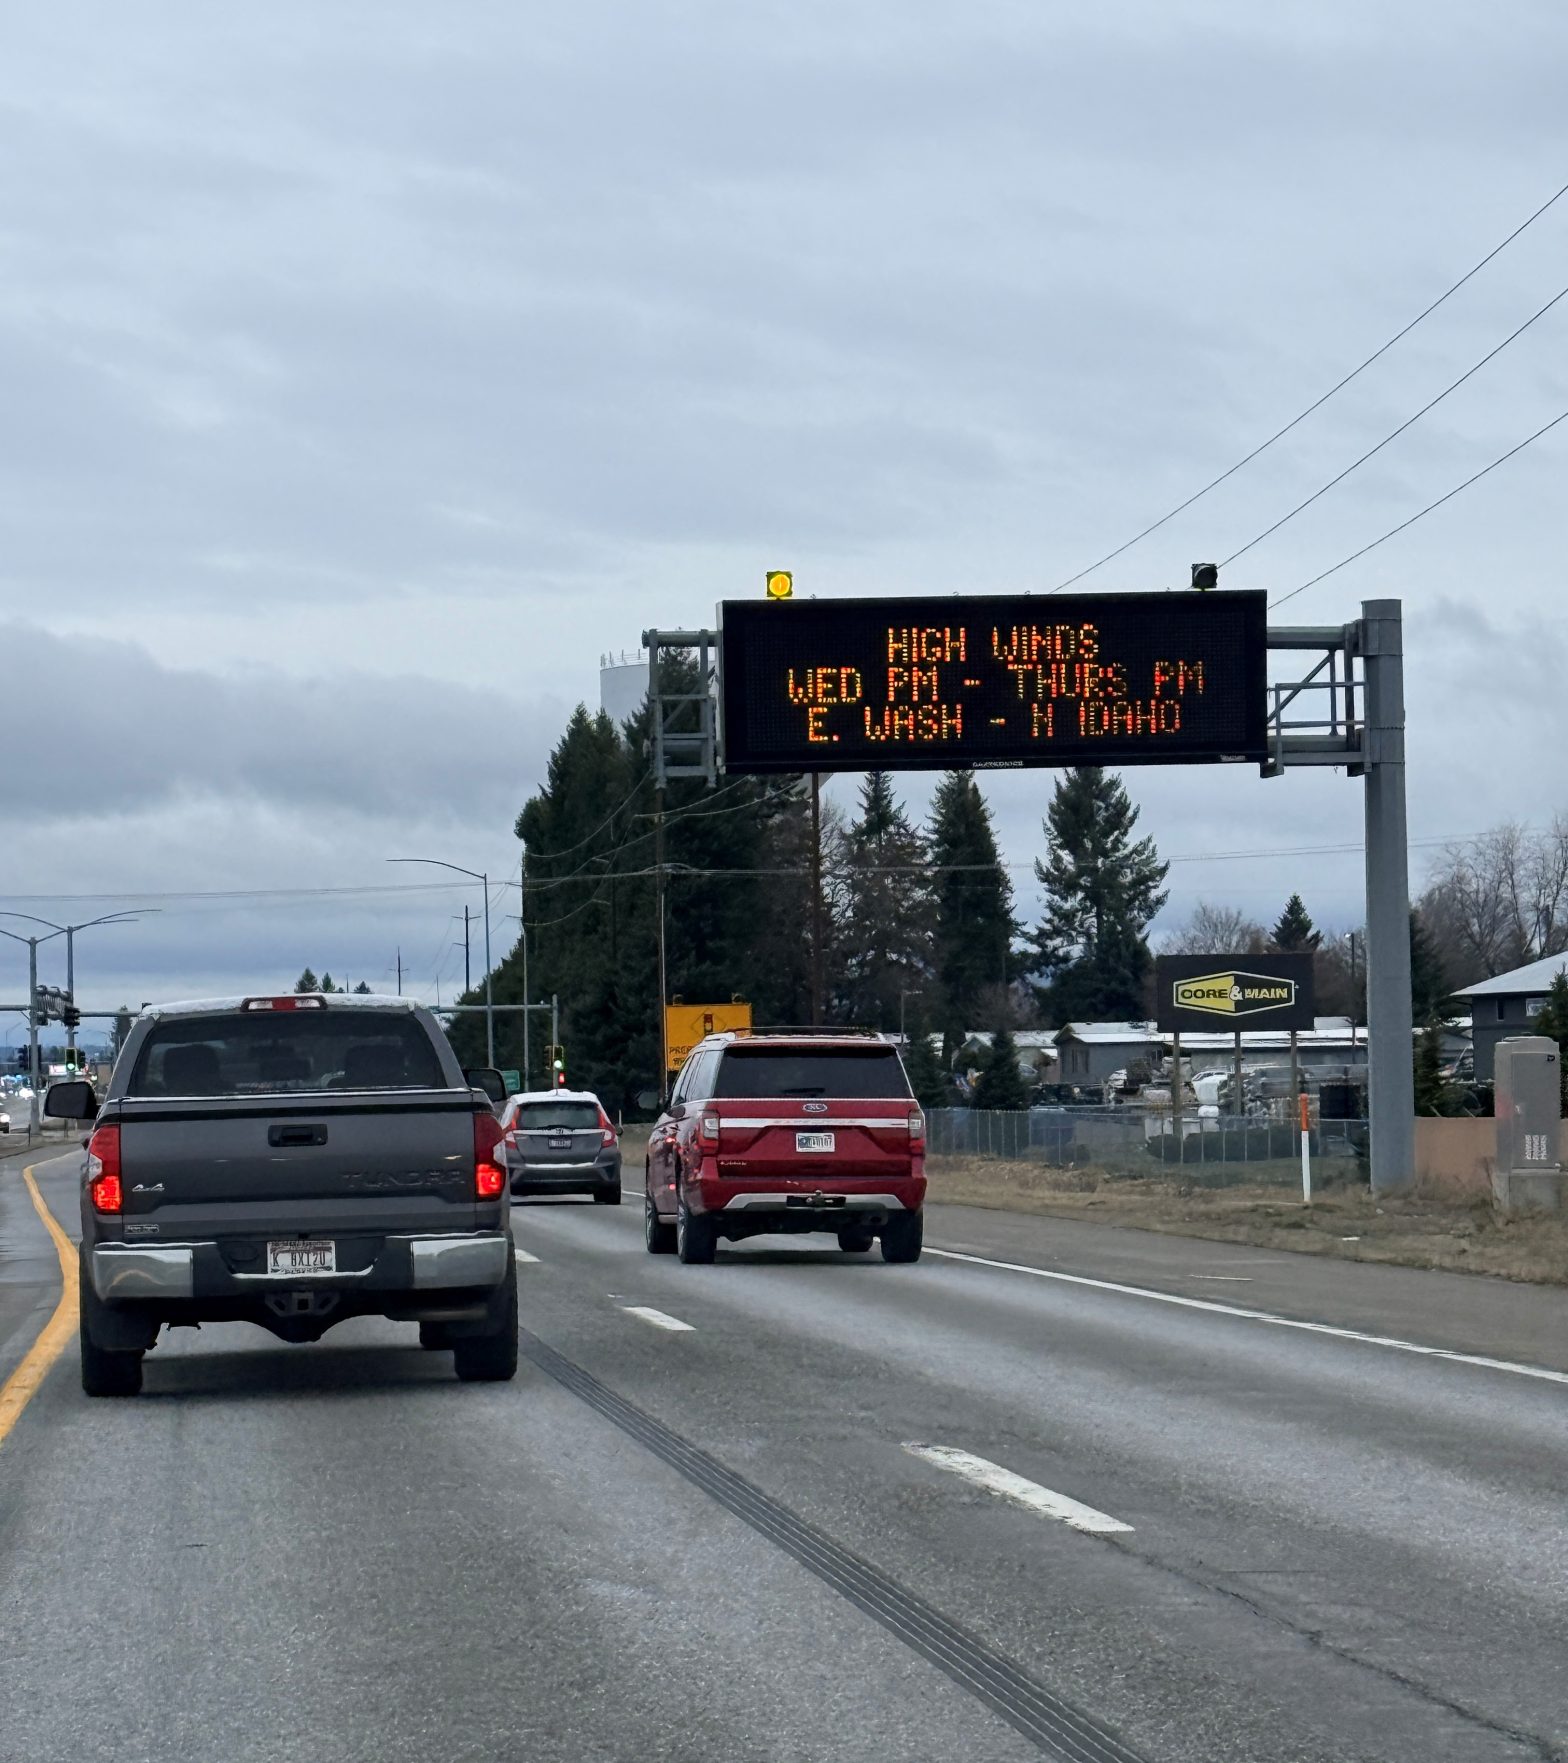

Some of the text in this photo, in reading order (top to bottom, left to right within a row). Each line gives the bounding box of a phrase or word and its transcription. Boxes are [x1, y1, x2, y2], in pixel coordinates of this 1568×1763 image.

[888, 623, 1099, 664] HIGH WINDS
[788, 667, 863, 704] WED
[888, 666, 939, 702] PM
[1007, 662, 1127, 699] THURS
[1154, 660, 1204, 696] PM
[808, 706, 839, 742] E.
[864, 704, 963, 740] WASH
[1031, 702, 1054, 737] N
[1079, 699, 1181, 736] IDAHO
[1180, 985, 1288, 1001] CORE & MAIN
